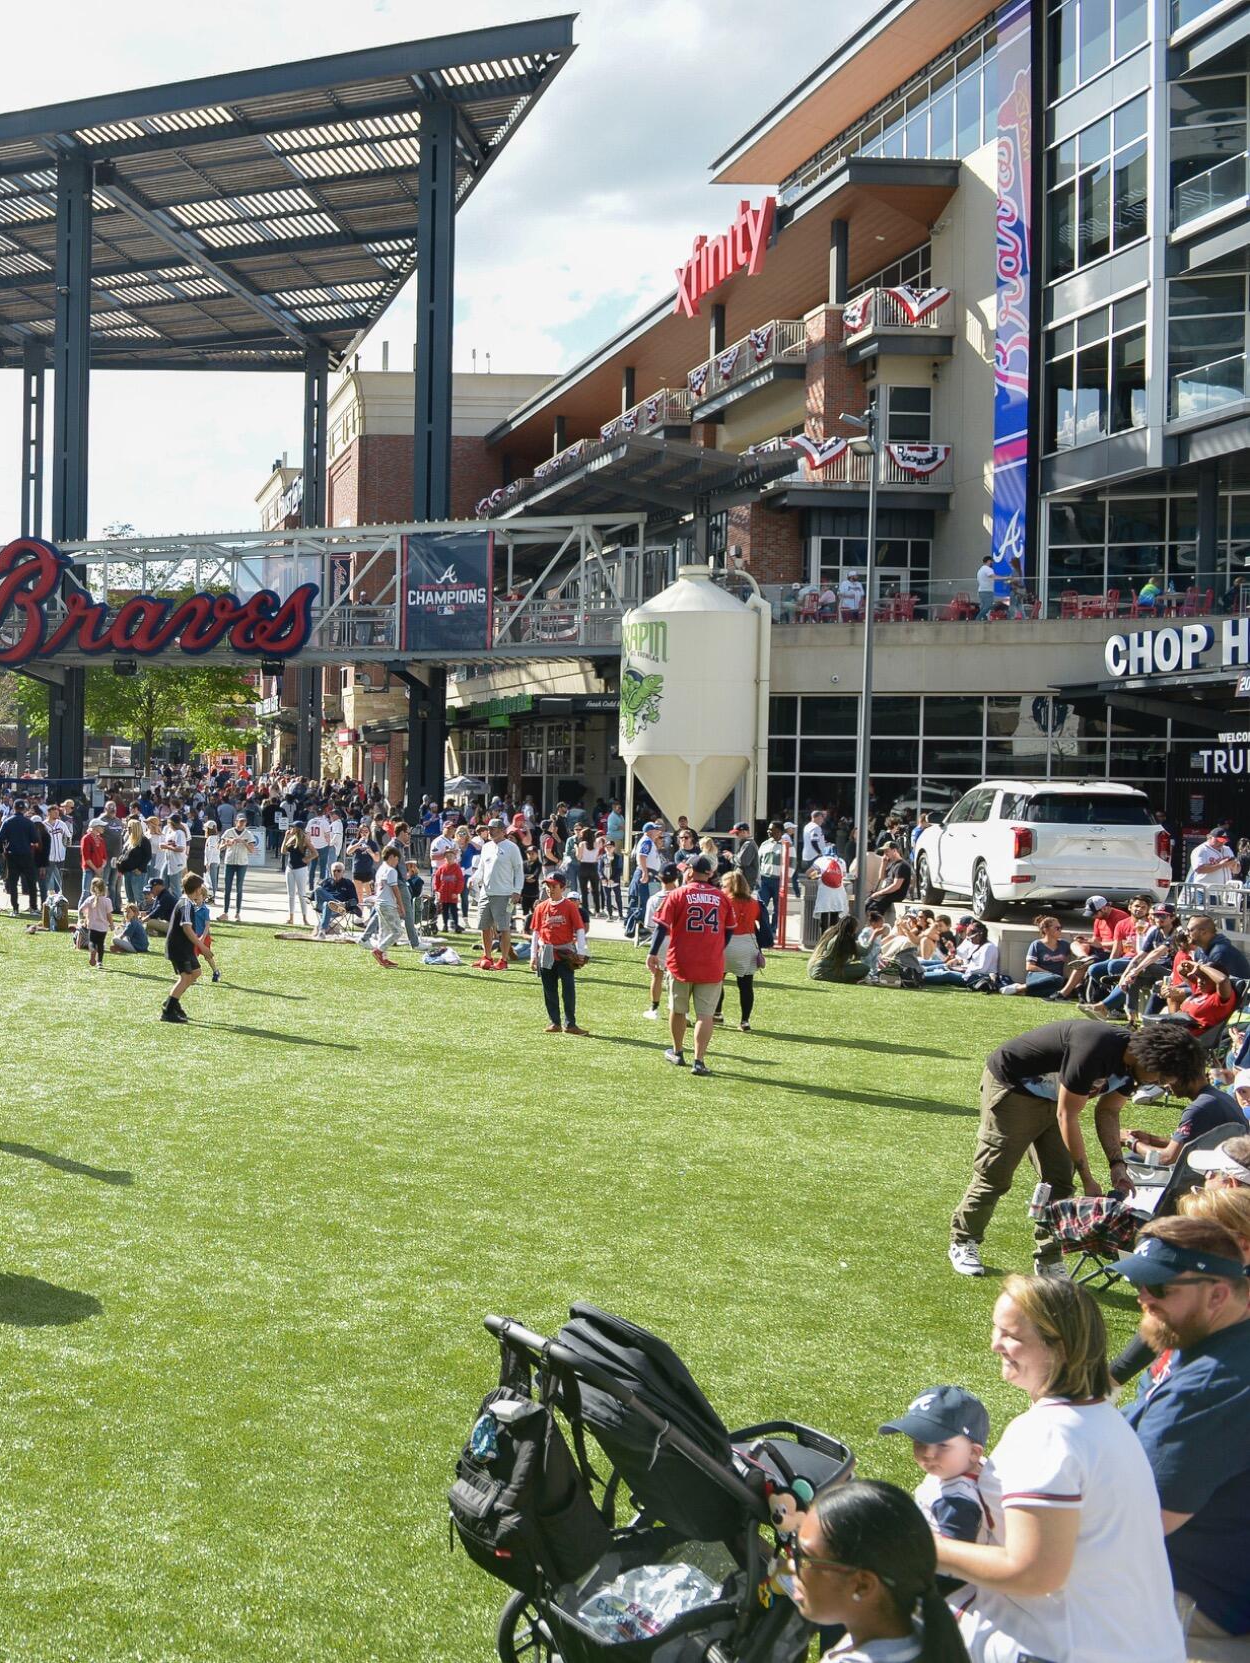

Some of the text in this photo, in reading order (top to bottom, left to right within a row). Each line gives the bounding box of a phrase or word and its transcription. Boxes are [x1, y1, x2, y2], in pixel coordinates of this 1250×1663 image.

[673, 196, 776, 318] xfinity
[407, 587, 486, 606] CHAMPIONS
[1105, 623, 1214, 677] CHOP
[310, 826, 321, 837] 10
[686, 906, 720, 933] 24
